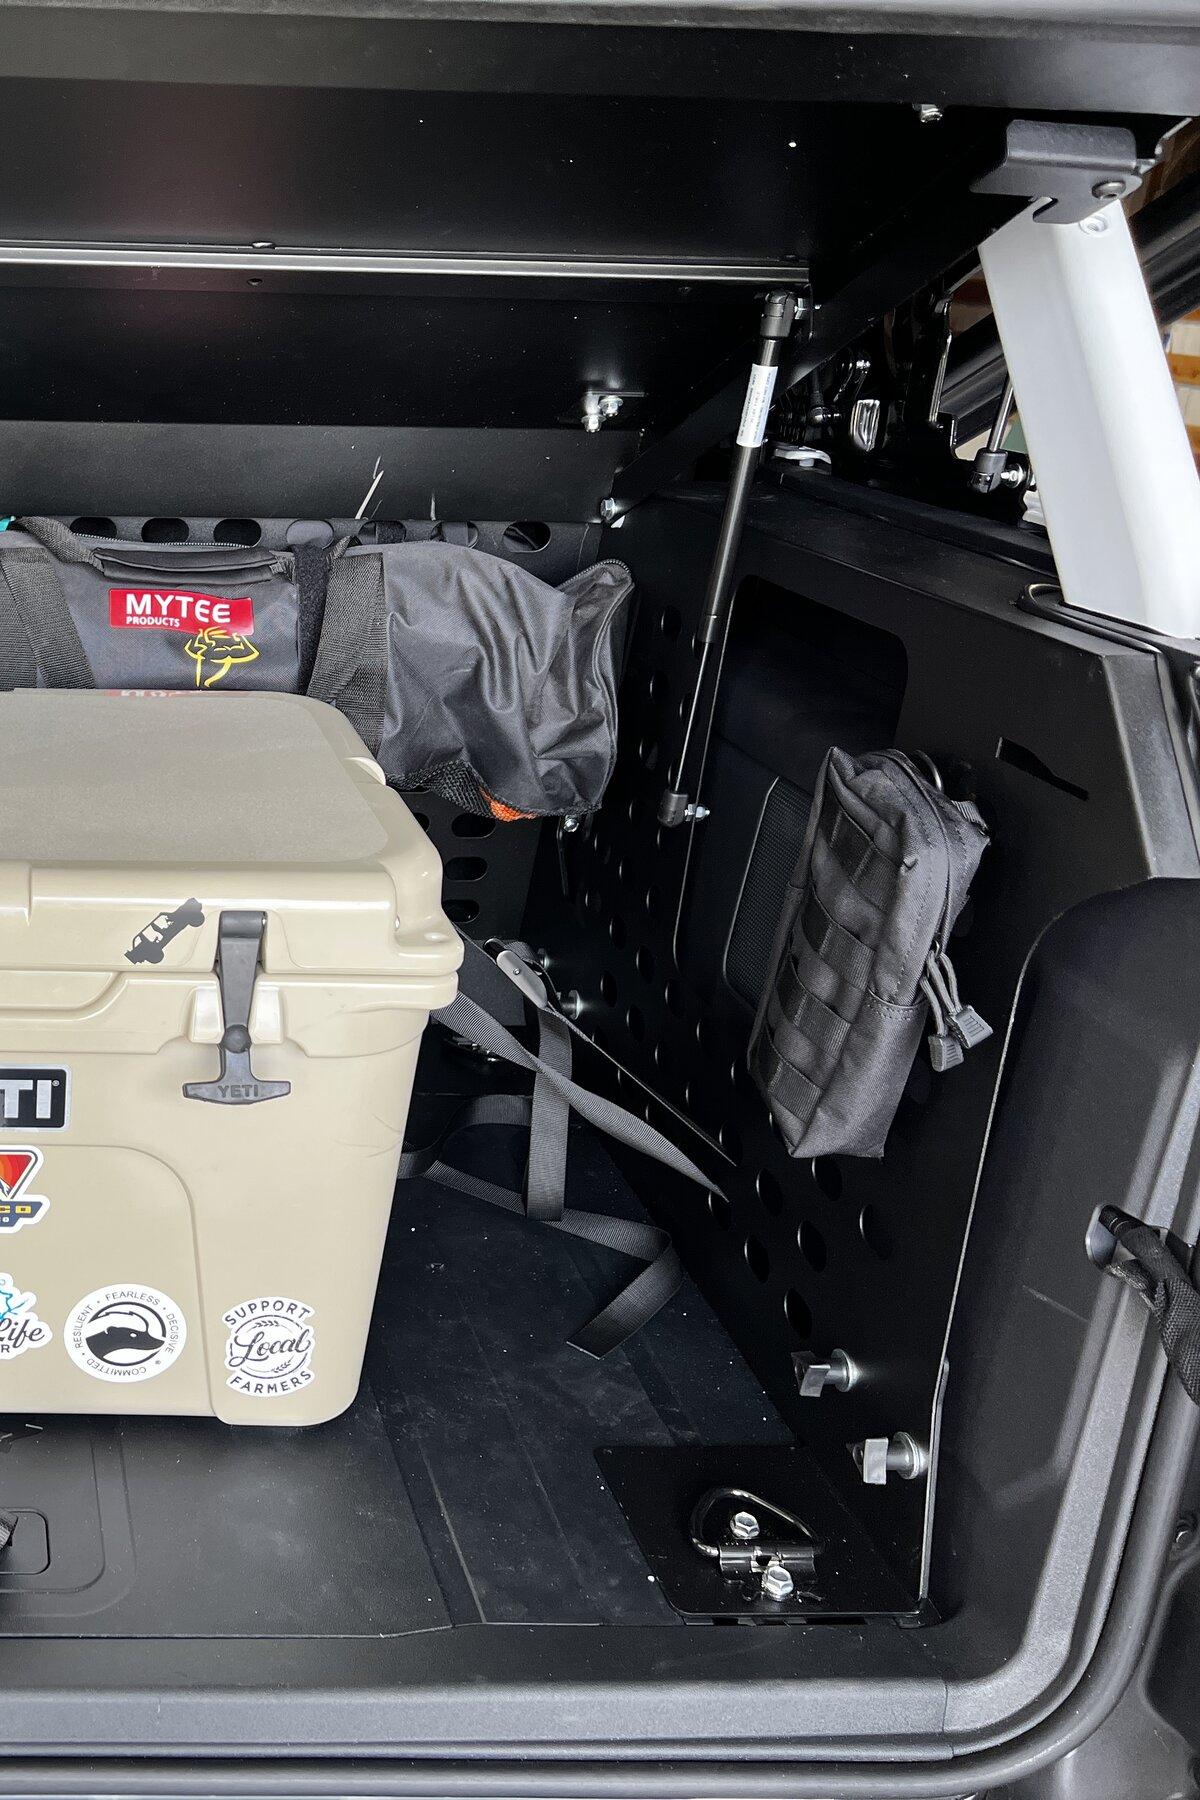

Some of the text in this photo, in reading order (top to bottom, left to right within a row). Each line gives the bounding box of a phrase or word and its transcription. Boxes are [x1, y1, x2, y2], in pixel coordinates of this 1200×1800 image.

[126, 593, 231, 624] MYTEE
[126, 616, 180, 628] PRODUCTS
[217, 1084, 259, 1098] YETI
[105, 1291, 161, 1306] FEARLESS
[224, 1300, 311, 1326] SUPPORT
[73, 1304, 93, 1349] RESILIENT
[164, 1313, 179, 1354] DECISIVE
[228, 1329, 312, 1367] Local
[86, 1358, 147, 1377] COMMITTED
[230, 1371, 312, 1394] FARMERS
